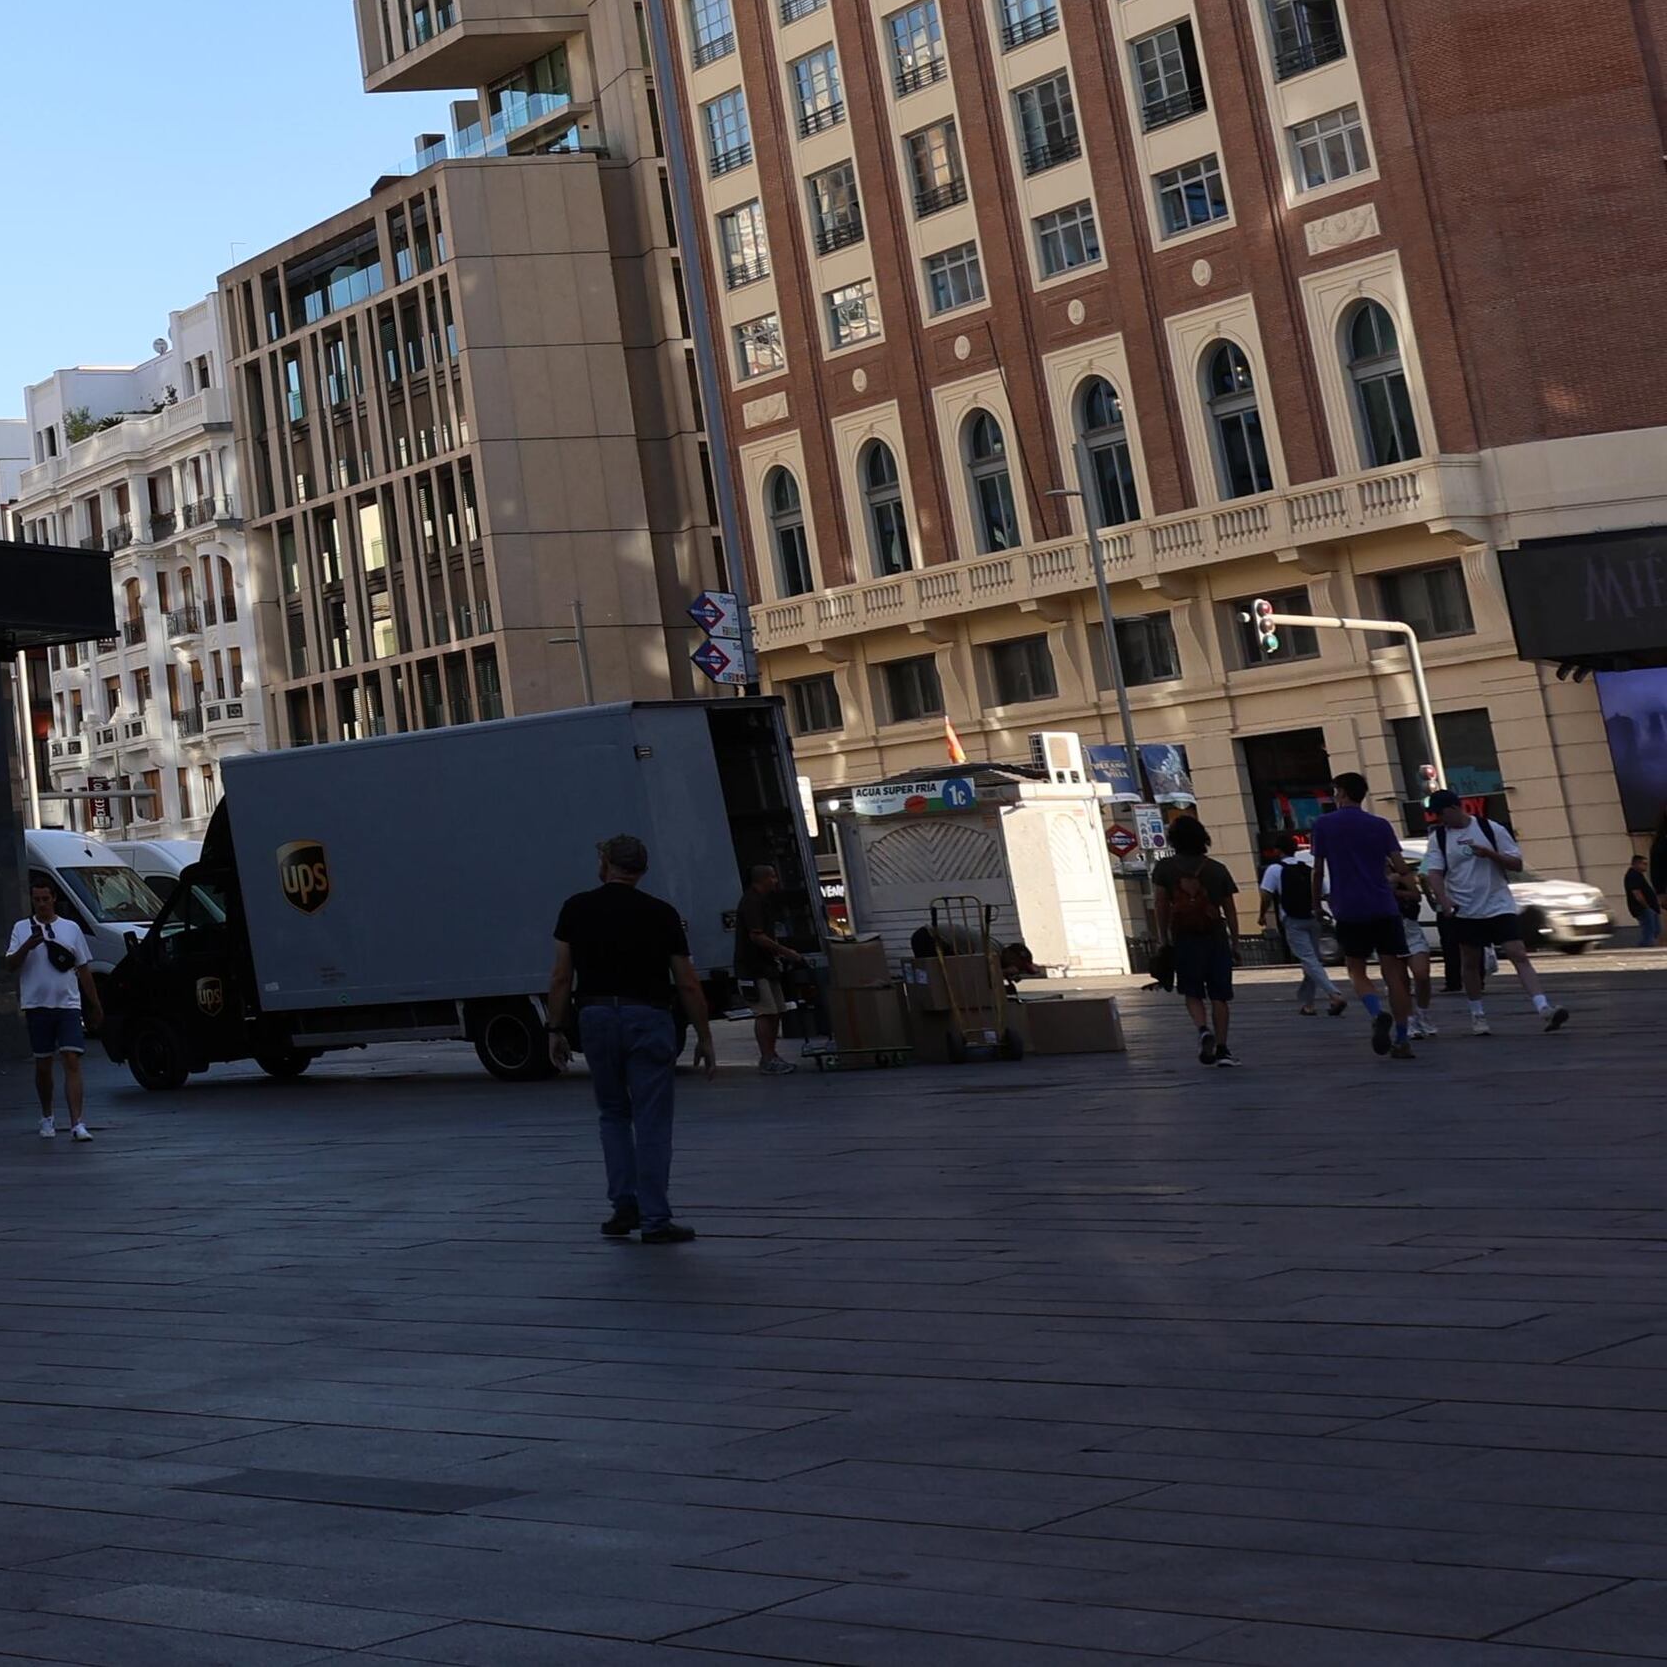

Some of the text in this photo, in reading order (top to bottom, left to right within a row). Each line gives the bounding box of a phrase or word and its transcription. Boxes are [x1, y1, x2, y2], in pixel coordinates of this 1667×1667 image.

[856, 788, 882, 797] AGUA
[883, 785, 913, 795] SUPER
[283, 863, 328, 904] ups
[198, 988, 222, 1005] ups
